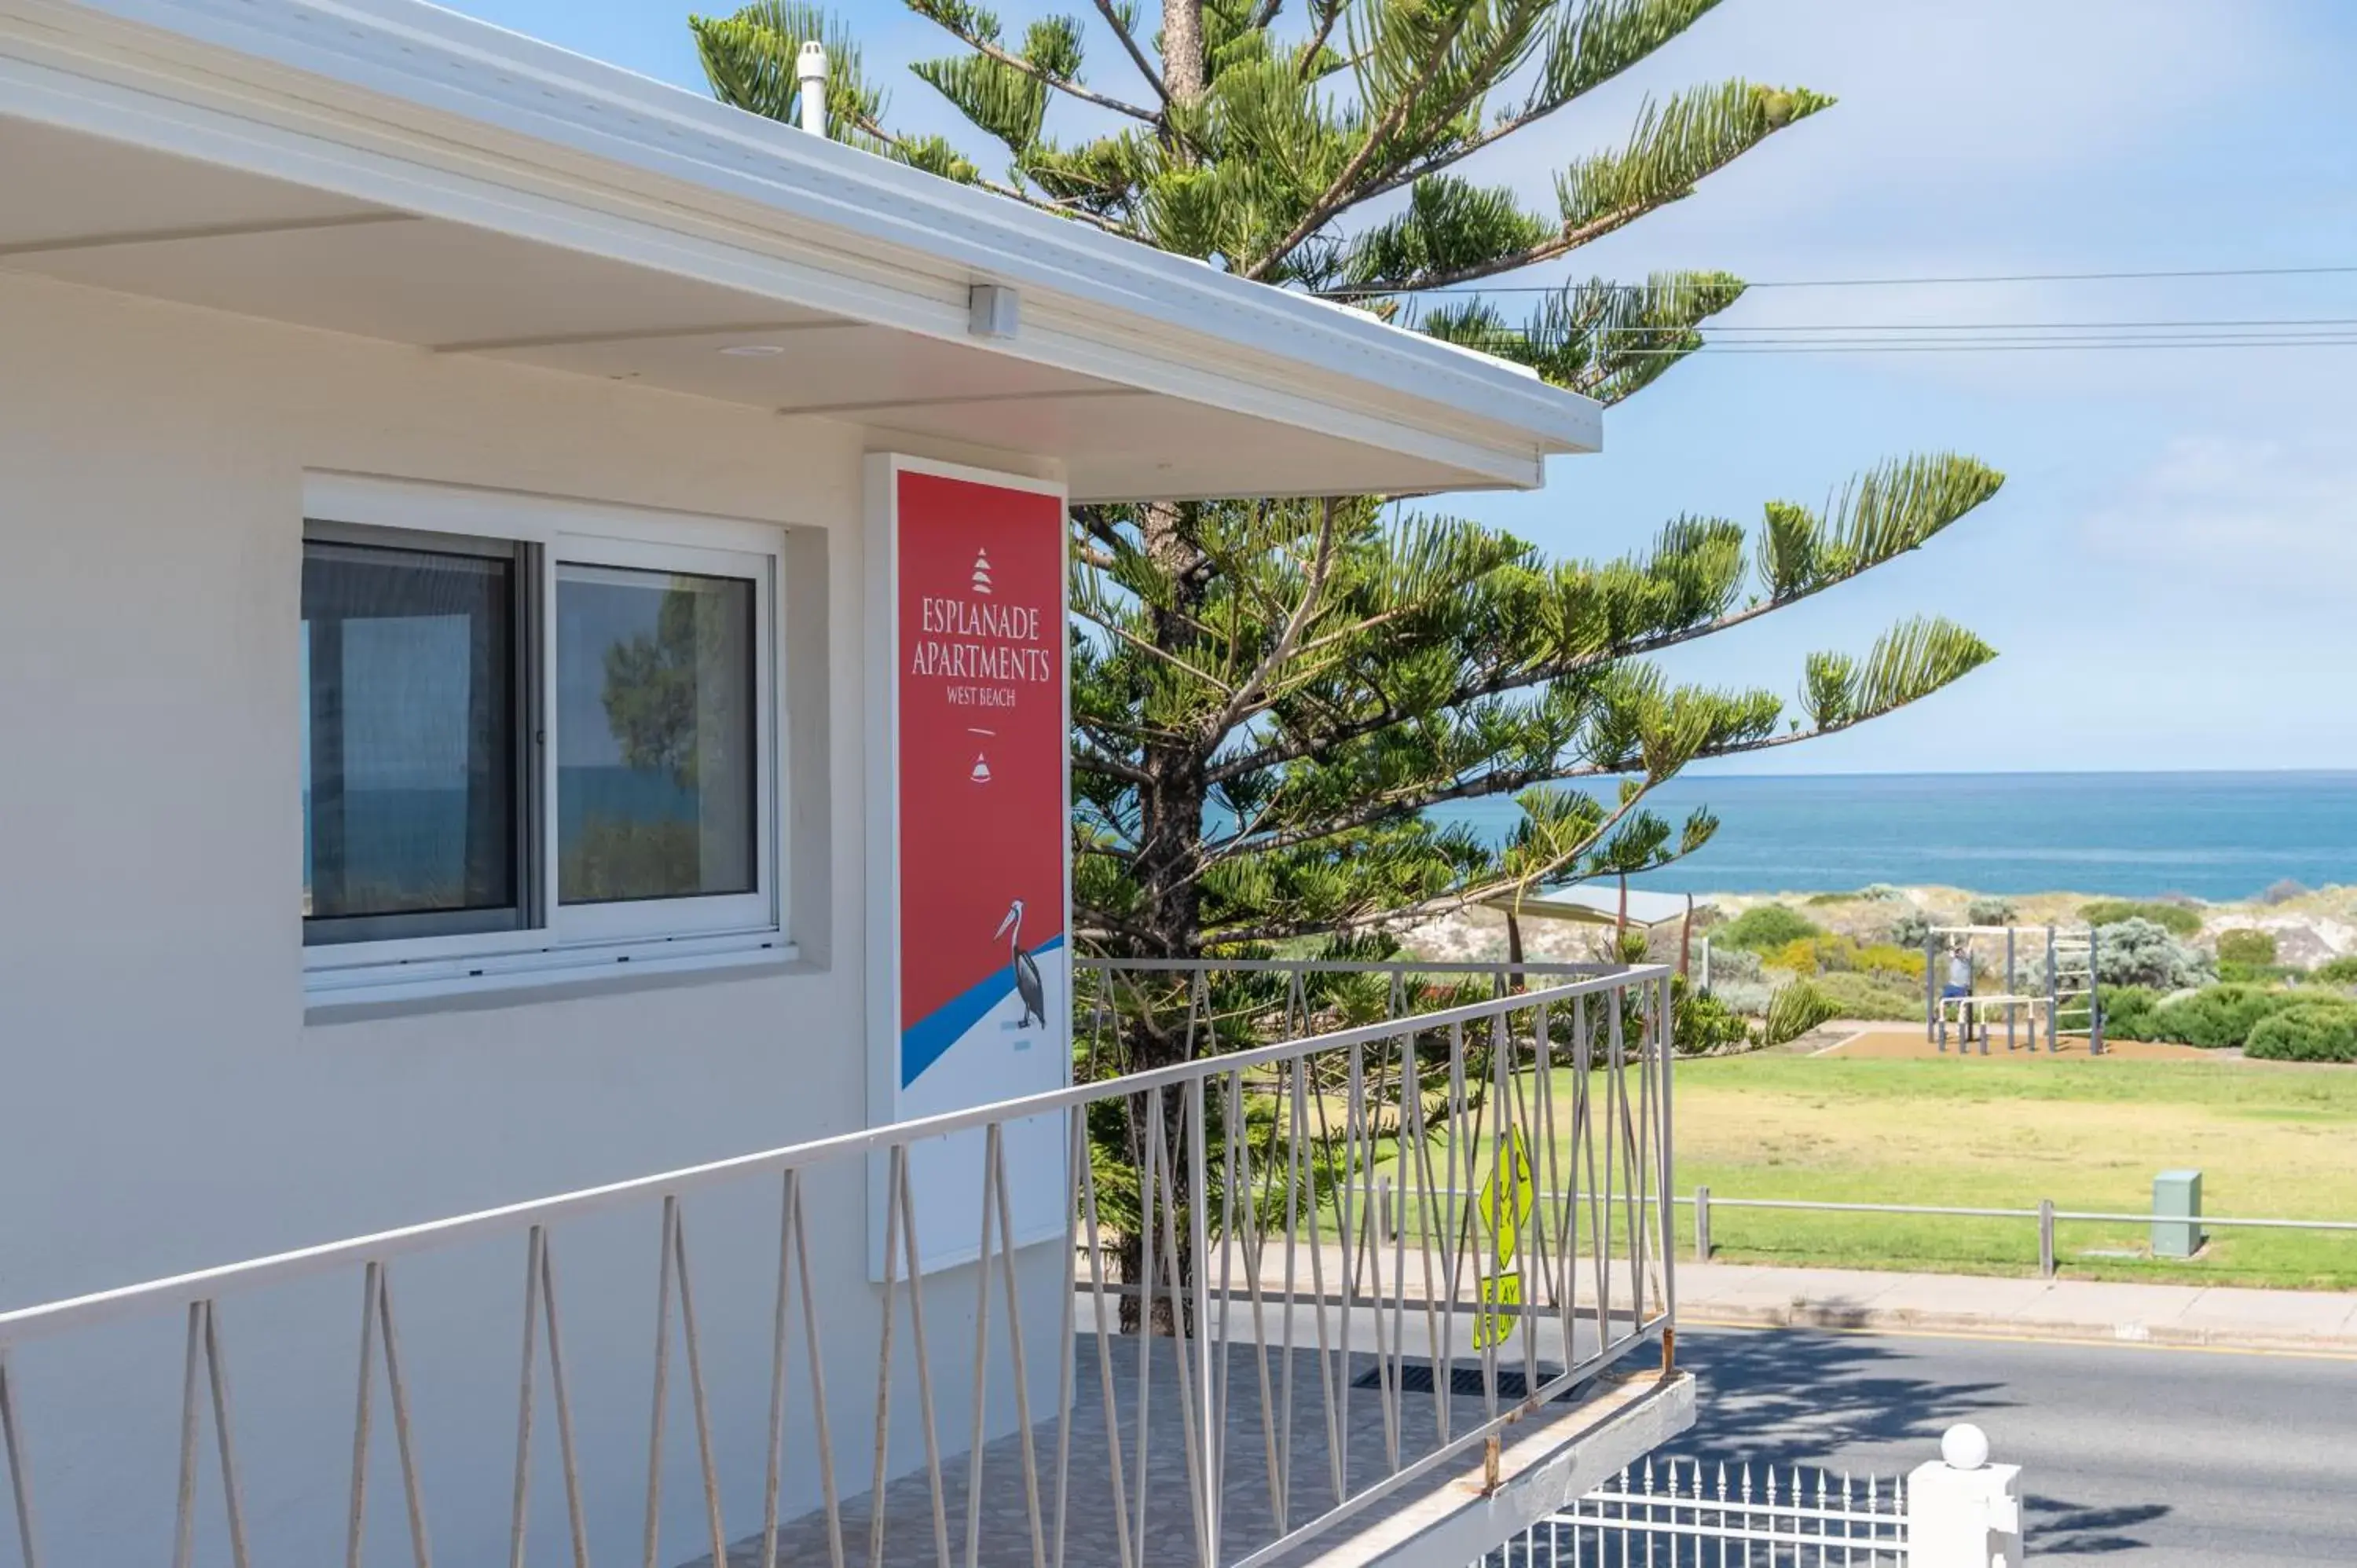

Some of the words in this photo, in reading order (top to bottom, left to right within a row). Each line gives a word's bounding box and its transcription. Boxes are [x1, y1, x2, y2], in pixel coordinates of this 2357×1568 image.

[922, 597, 1039, 640] ESPLANADE
[911, 640, 1050, 682] APARTMENTS
[947, 685, 977, 705] WEST
[980, 687, 1015, 707] BEACH
